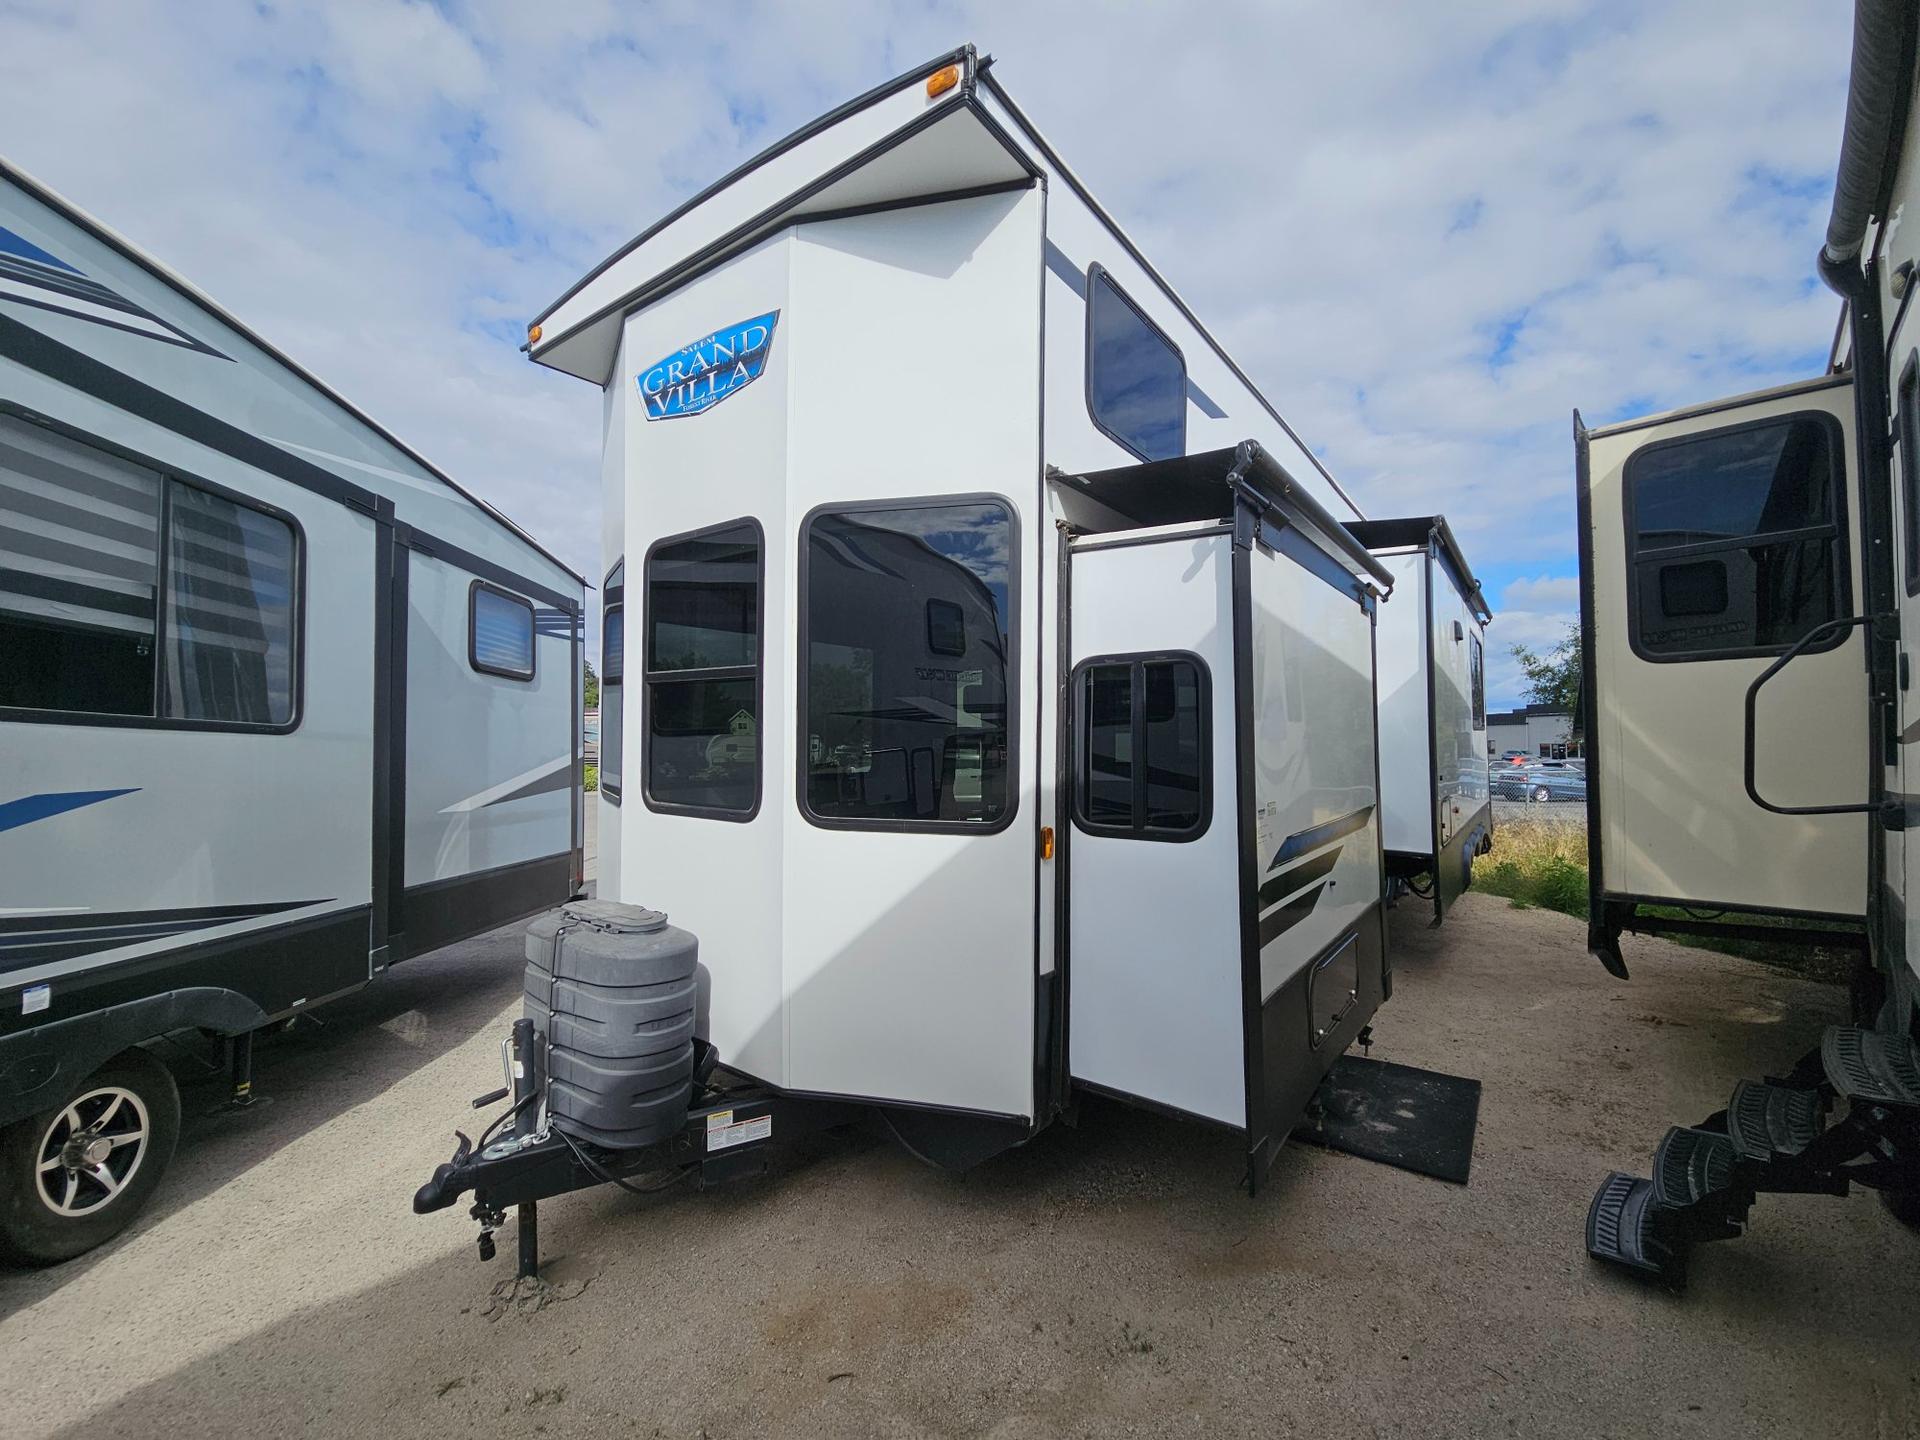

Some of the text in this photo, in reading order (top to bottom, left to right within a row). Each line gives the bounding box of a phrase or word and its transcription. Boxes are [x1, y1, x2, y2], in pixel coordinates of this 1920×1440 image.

[643, 325, 768, 394] GRAND
[681, 335, 716, 356] SALEM
[652, 361, 752, 415] VILLA
